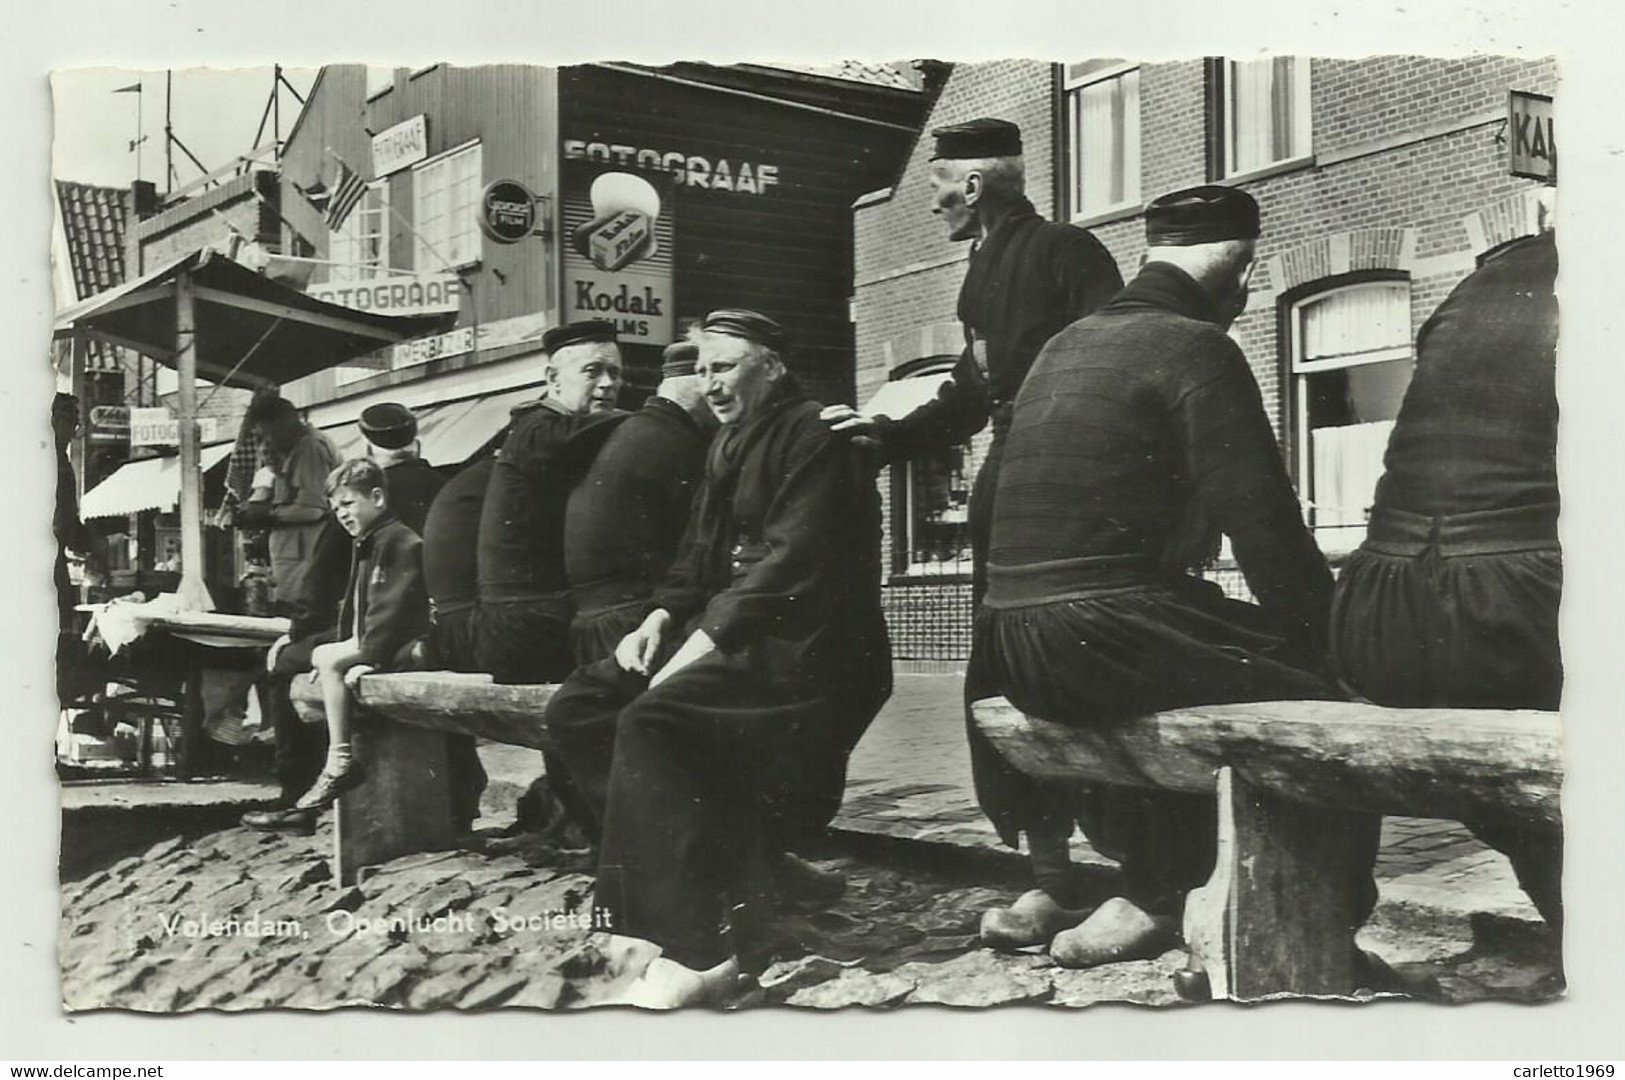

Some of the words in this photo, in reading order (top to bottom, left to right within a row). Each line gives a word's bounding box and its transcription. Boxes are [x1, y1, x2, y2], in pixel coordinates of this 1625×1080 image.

[564, 140, 779, 194] FOTOGRAAF
[574, 279, 664, 317] Kodak
[592, 316, 650, 336] LMS
